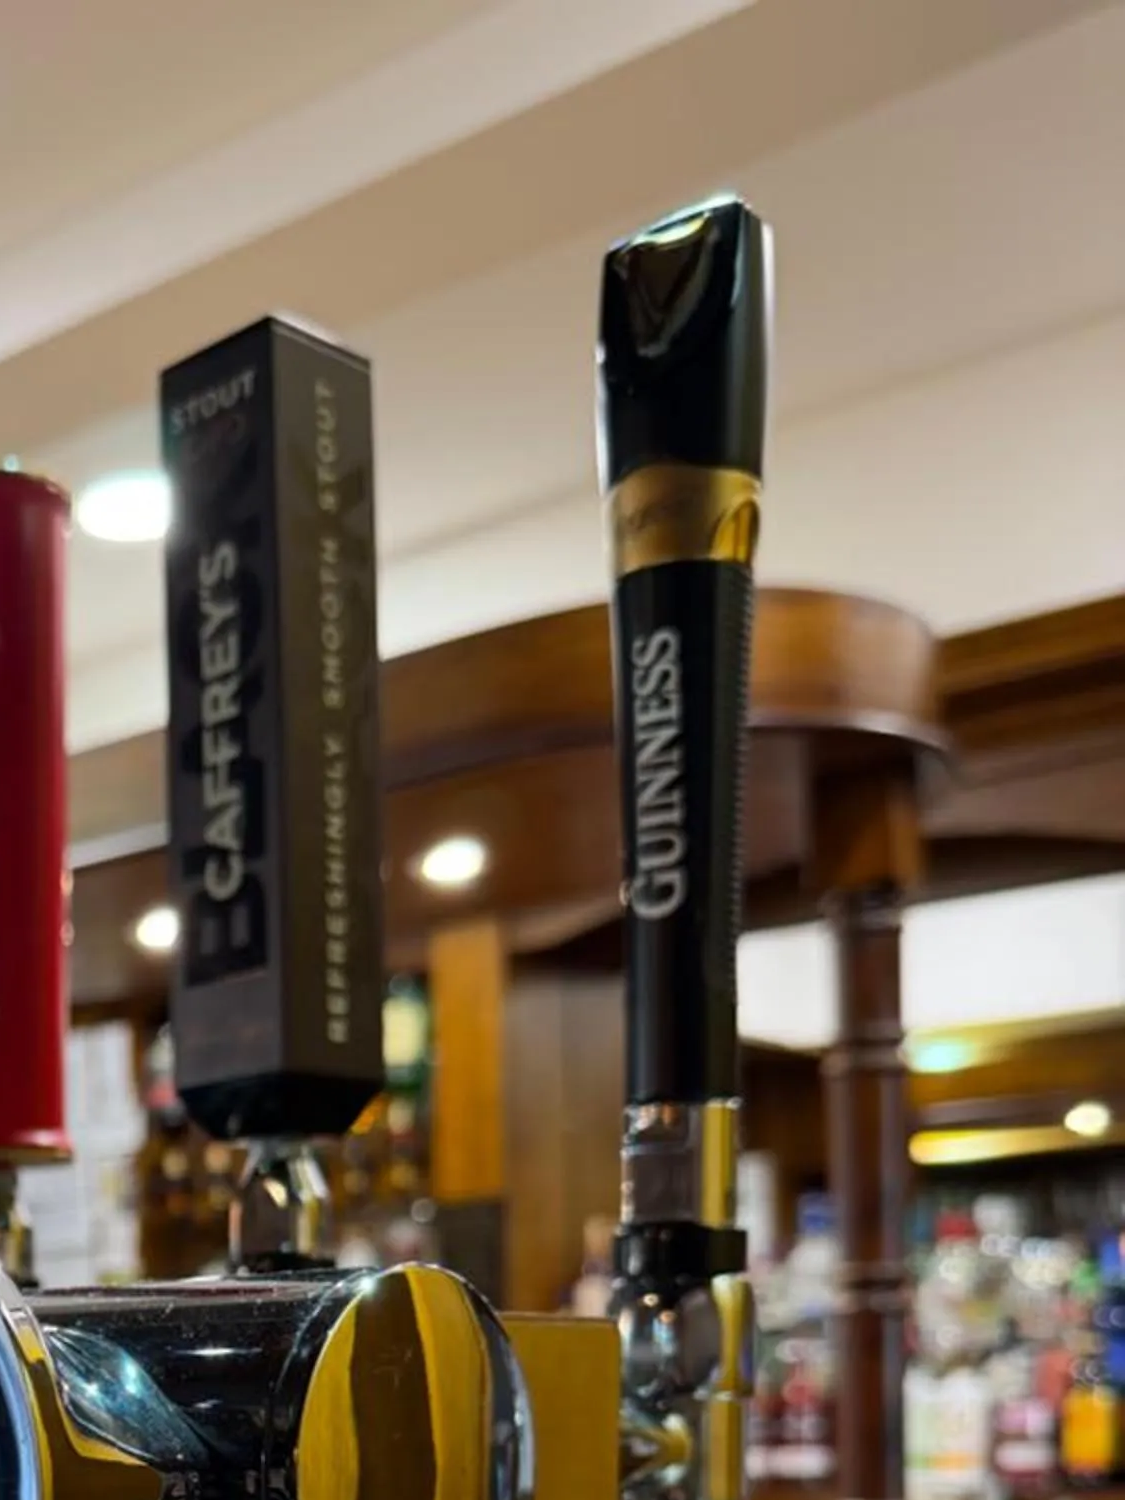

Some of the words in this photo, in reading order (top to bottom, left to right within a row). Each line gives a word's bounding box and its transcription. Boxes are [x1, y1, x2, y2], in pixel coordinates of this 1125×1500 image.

[170, 368, 256, 436] STOUT
[313, 377, 339, 512] STOUT
[319, 537, 345, 708] SMOOTH
[197, 538, 248, 903] CAFFREY'S
[631, 628, 685, 919] GUINNESS
